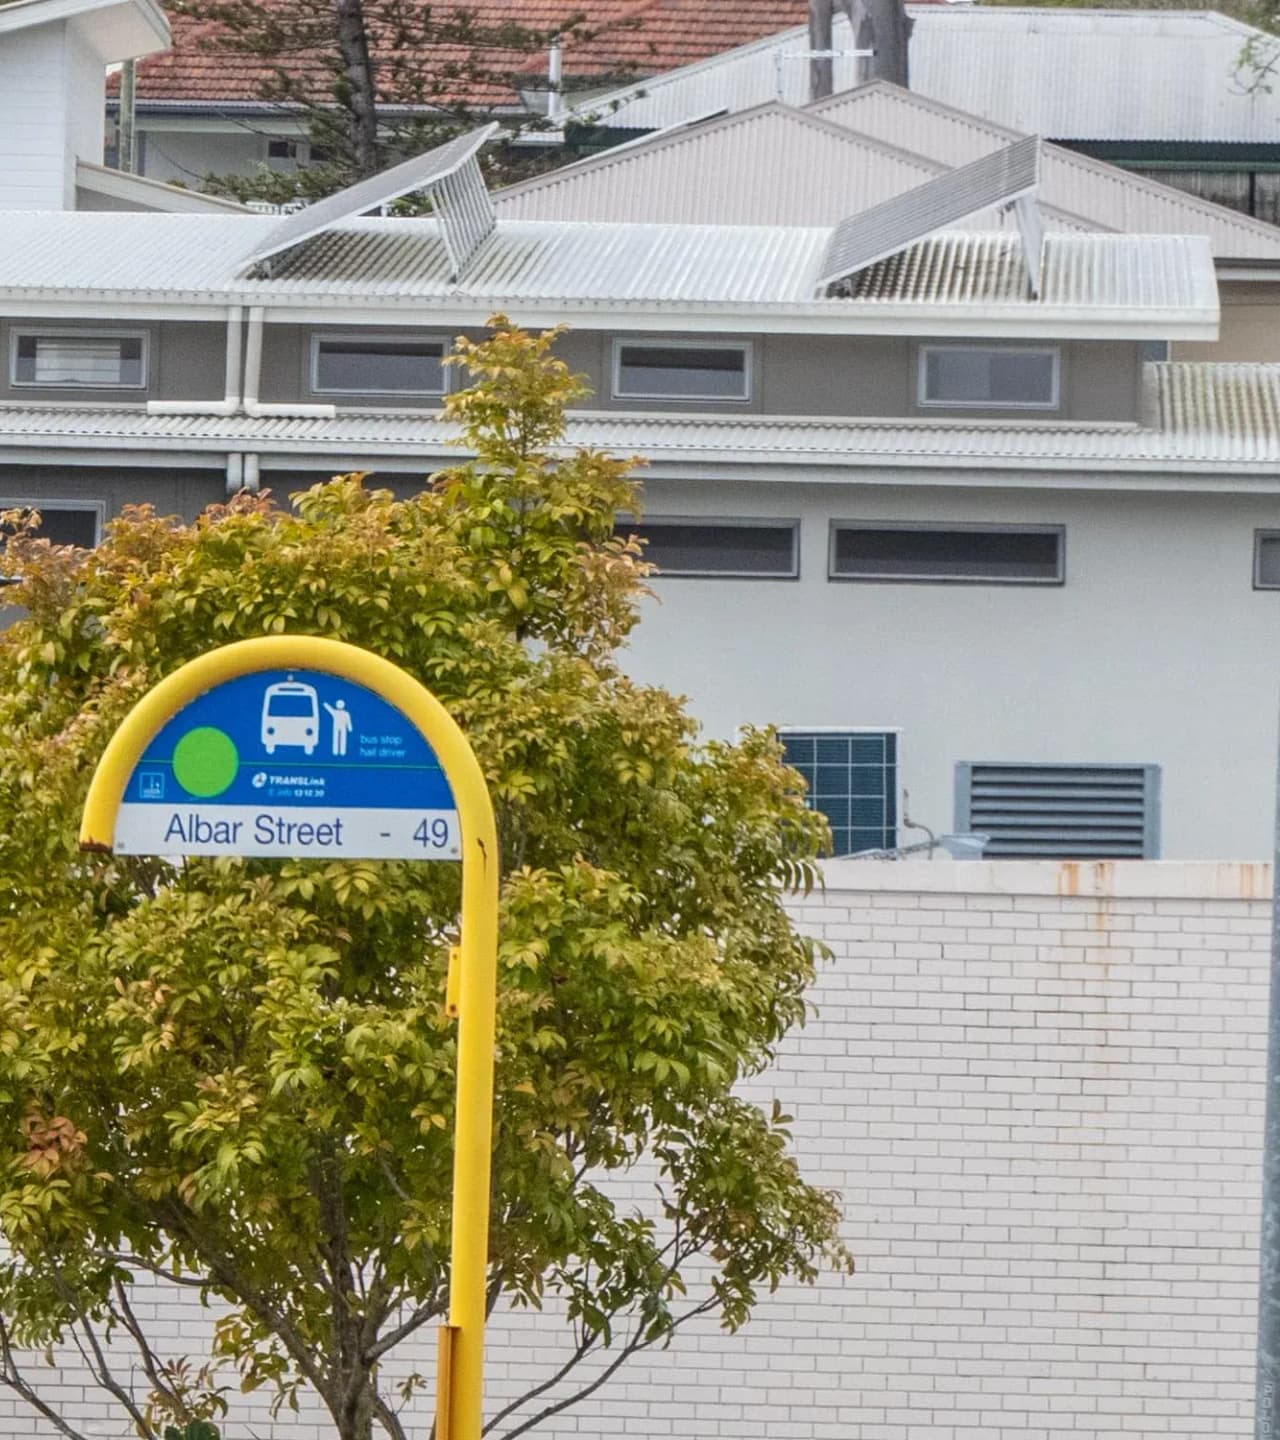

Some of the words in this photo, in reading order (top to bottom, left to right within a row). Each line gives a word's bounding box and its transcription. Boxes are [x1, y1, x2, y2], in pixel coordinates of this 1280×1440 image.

[360, 735, 378, 745] bus
[381, 736, 402, 747] stop
[378, 748, 406, 758] driver
[164, 813, 243, 845] Albar
[254, 813, 343, 847] Street
[412, 818, 449, 848] 49
